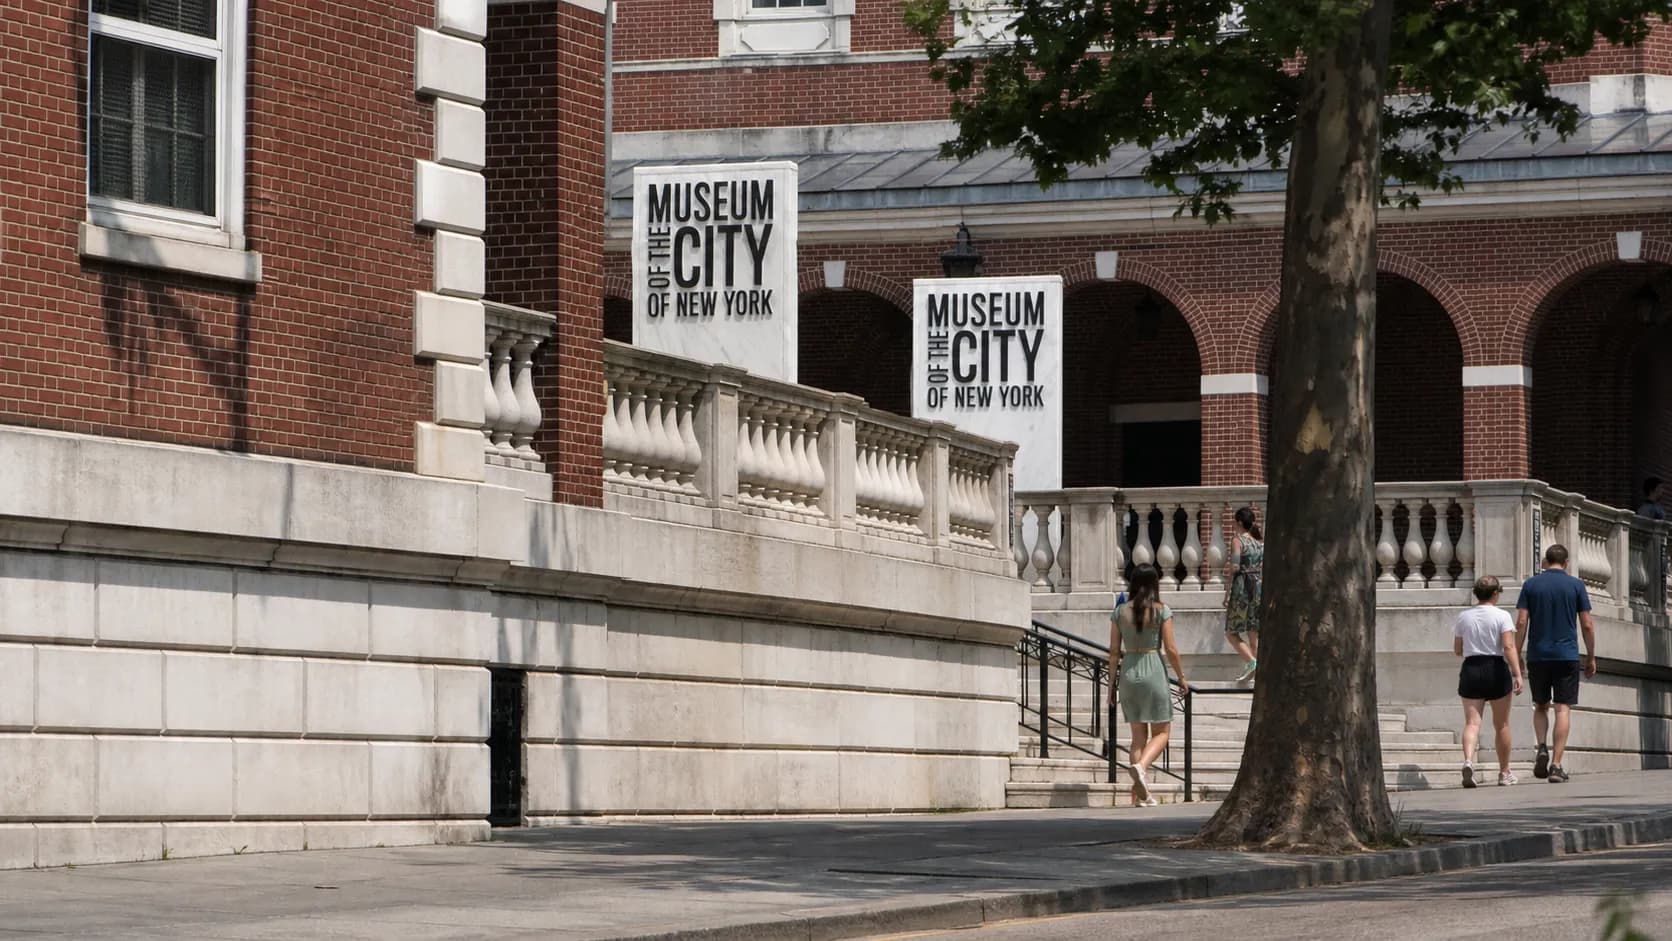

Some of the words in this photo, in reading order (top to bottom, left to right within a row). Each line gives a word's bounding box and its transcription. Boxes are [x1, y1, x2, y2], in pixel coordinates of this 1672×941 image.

[648, 179, 774, 223] MUSEUM
[648, 226, 671, 262] THE
[673, 223, 773, 288] CITY
[647, 265, 670, 288] OF
[647, 292, 670, 318] OF
[676, 290, 717, 317] NEW
[723, 289, 773, 316] YORK
[928, 291, 1045, 327] MUSEUM
[928, 331, 949, 360] THE
[952, 329, 1044, 383] CITY
[928, 364, 949, 384] OF
[928, 387, 949, 409] OF
[954, 386, 993, 408] NEW
[999, 385, 1044, 407] YORK
